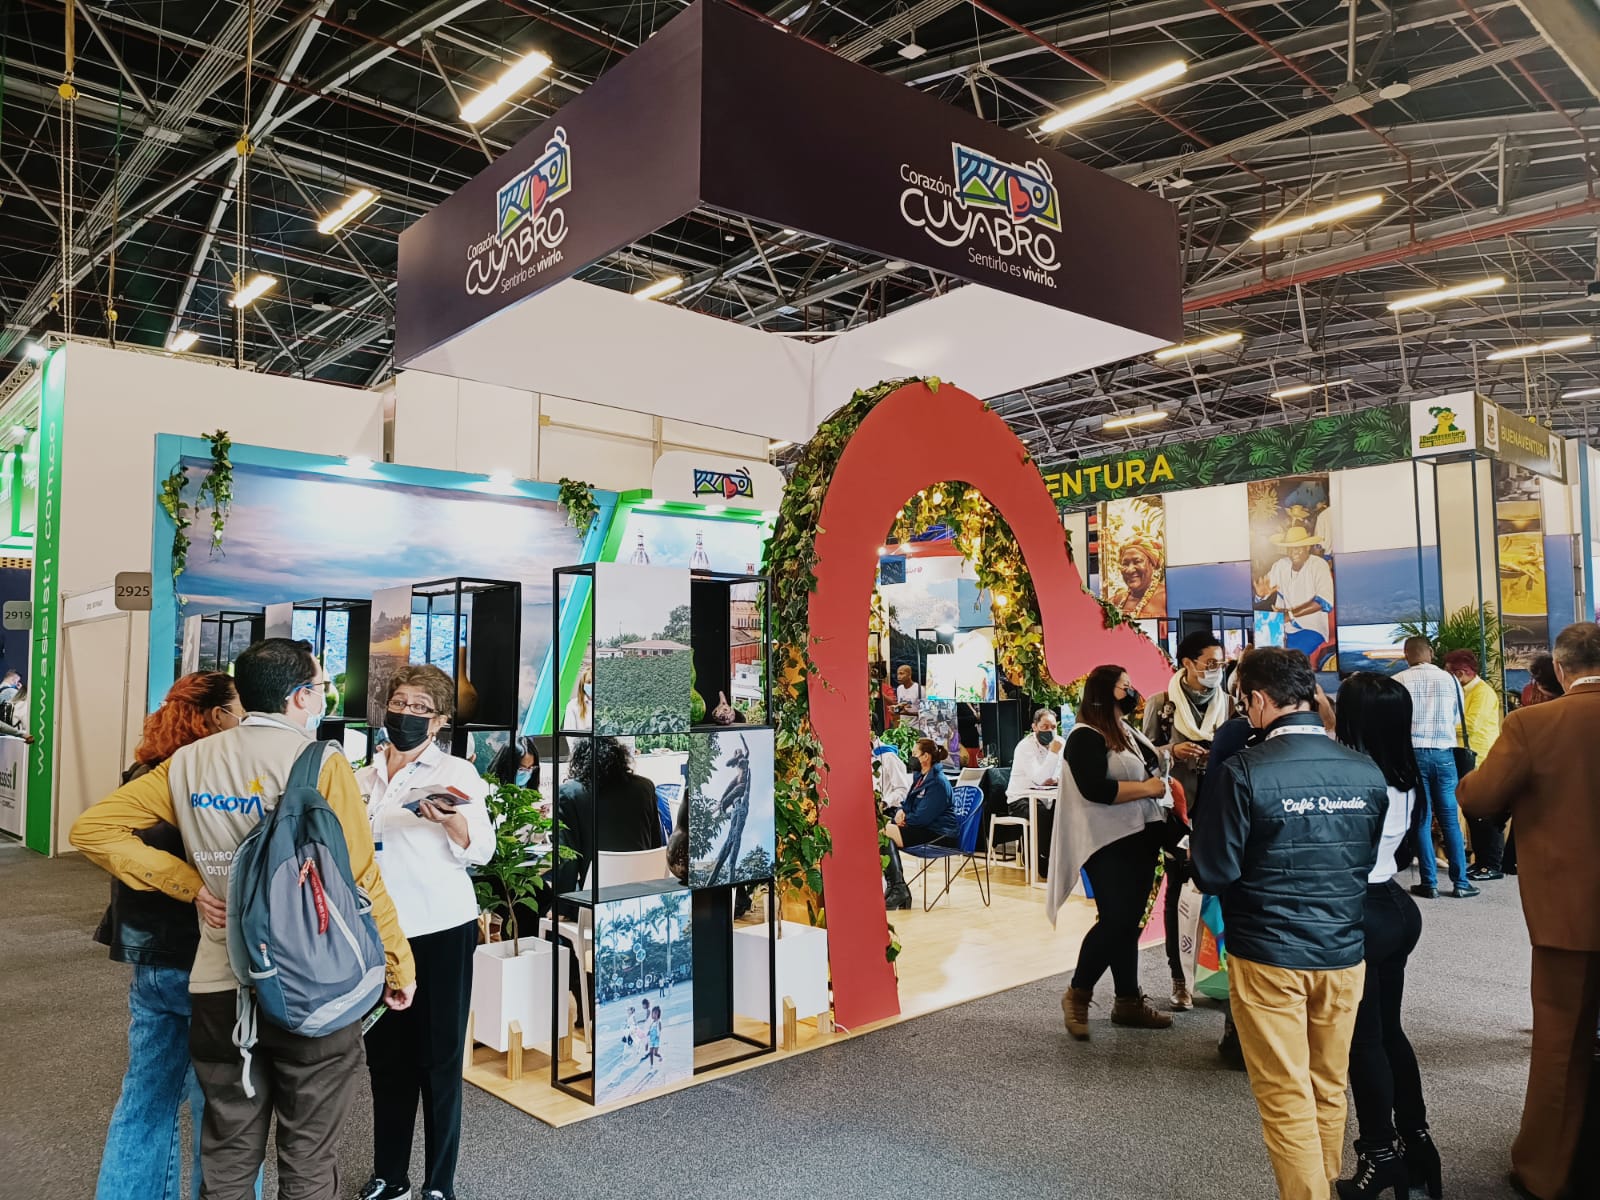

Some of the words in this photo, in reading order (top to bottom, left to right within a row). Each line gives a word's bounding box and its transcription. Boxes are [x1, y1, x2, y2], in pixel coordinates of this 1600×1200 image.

[900, 163, 951, 195] Corazón
[467, 232, 497, 261] Corazón
[501, 267, 527, 294] Sentirlo
[527, 262, 536, 279] es
[537, 247, 564, 273] vivirlo.
[968, 247, 1008, 273] Sentirlo
[1009, 263, 1022, 277] es
[1022, 265, 1057, 288] vivirlo.
[1500, 424, 1548, 457] BUENAVENTURA
[117, 585, 150, 597] 2925
[5, 610, 31, 620] 2919
[1281, 797, 1315, 814] Café
[1318, 796, 1367, 813] Quindío
